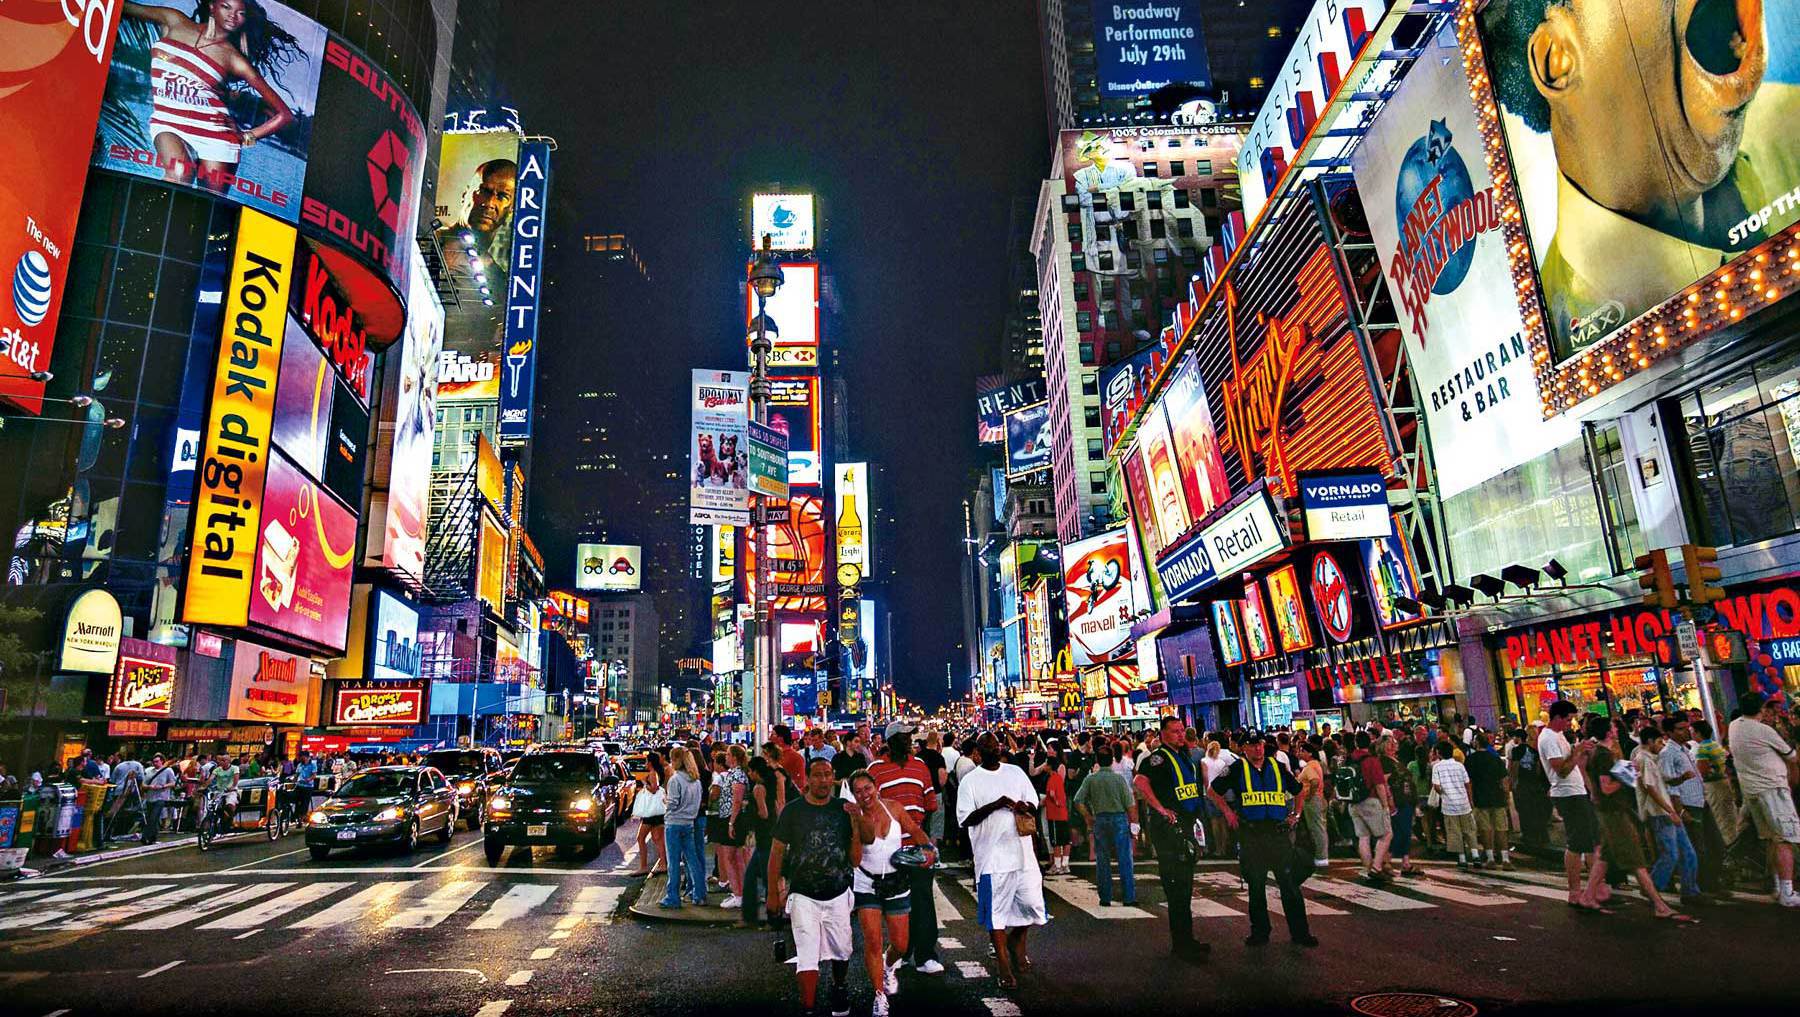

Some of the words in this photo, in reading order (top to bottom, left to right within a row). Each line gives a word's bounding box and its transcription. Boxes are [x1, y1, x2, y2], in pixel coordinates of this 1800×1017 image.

[1113, 2, 1180, 21] Broadway
[1105, 24, 1194, 42] Performance
[1119, 43, 1148, 66] July
[1152, 43, 1186, 61] 29th
[1112, 129, 1138, 137] 100%
[1140, 128, 1198, 137] Colombian
[1200, 126, 1236, 134] Coffee
[110, 144, 288, 208] SOUTHPOLE
[1728, 204, 1772, 246] STOP
[26, 216, 42, 243] The
[42, 236, 61, 260] new
[511, 154, 544, 329] ARGENT
[1390, 174, 1444, 316] PLANET
[226, 251, 282, 403] Kodak
[304, 254, 369, 398] Kodak
[1569, 309, 1615, 347] MAX
[1, 327, 40, 373] at&t
[699, 388, 743, 403] BROADWAY
[979, 382, 1036, 416] RENT
[1461, 402, 1472, 421] &
[1474, 376, 1511, 414] BAR
[202, 413, 259, 580] digital
[1306, 483, 1381, 498] VORNADO
[1331, 511, 1365, 523] Retail
[1161, 547, 1210, 594] VORNADO
[1214, 512, 1263, 563] Retail
[787, 559, 797, 572] 45
[802, 584, 825, 593] ABBOTT
[73, 622, 114, 637] Marriott
[1081, 615, 1115, 634] maxell
[1506, 621, 1603, 670] PLANET
[1772, 642, 1782, 660] &
[341, 680, 425, 689] MARQUIS
[344, 700, 413, 720] Chaperone
[360, 691, 401, 709] DROWSY
[1242, 793, 1285, 804] POLICE
